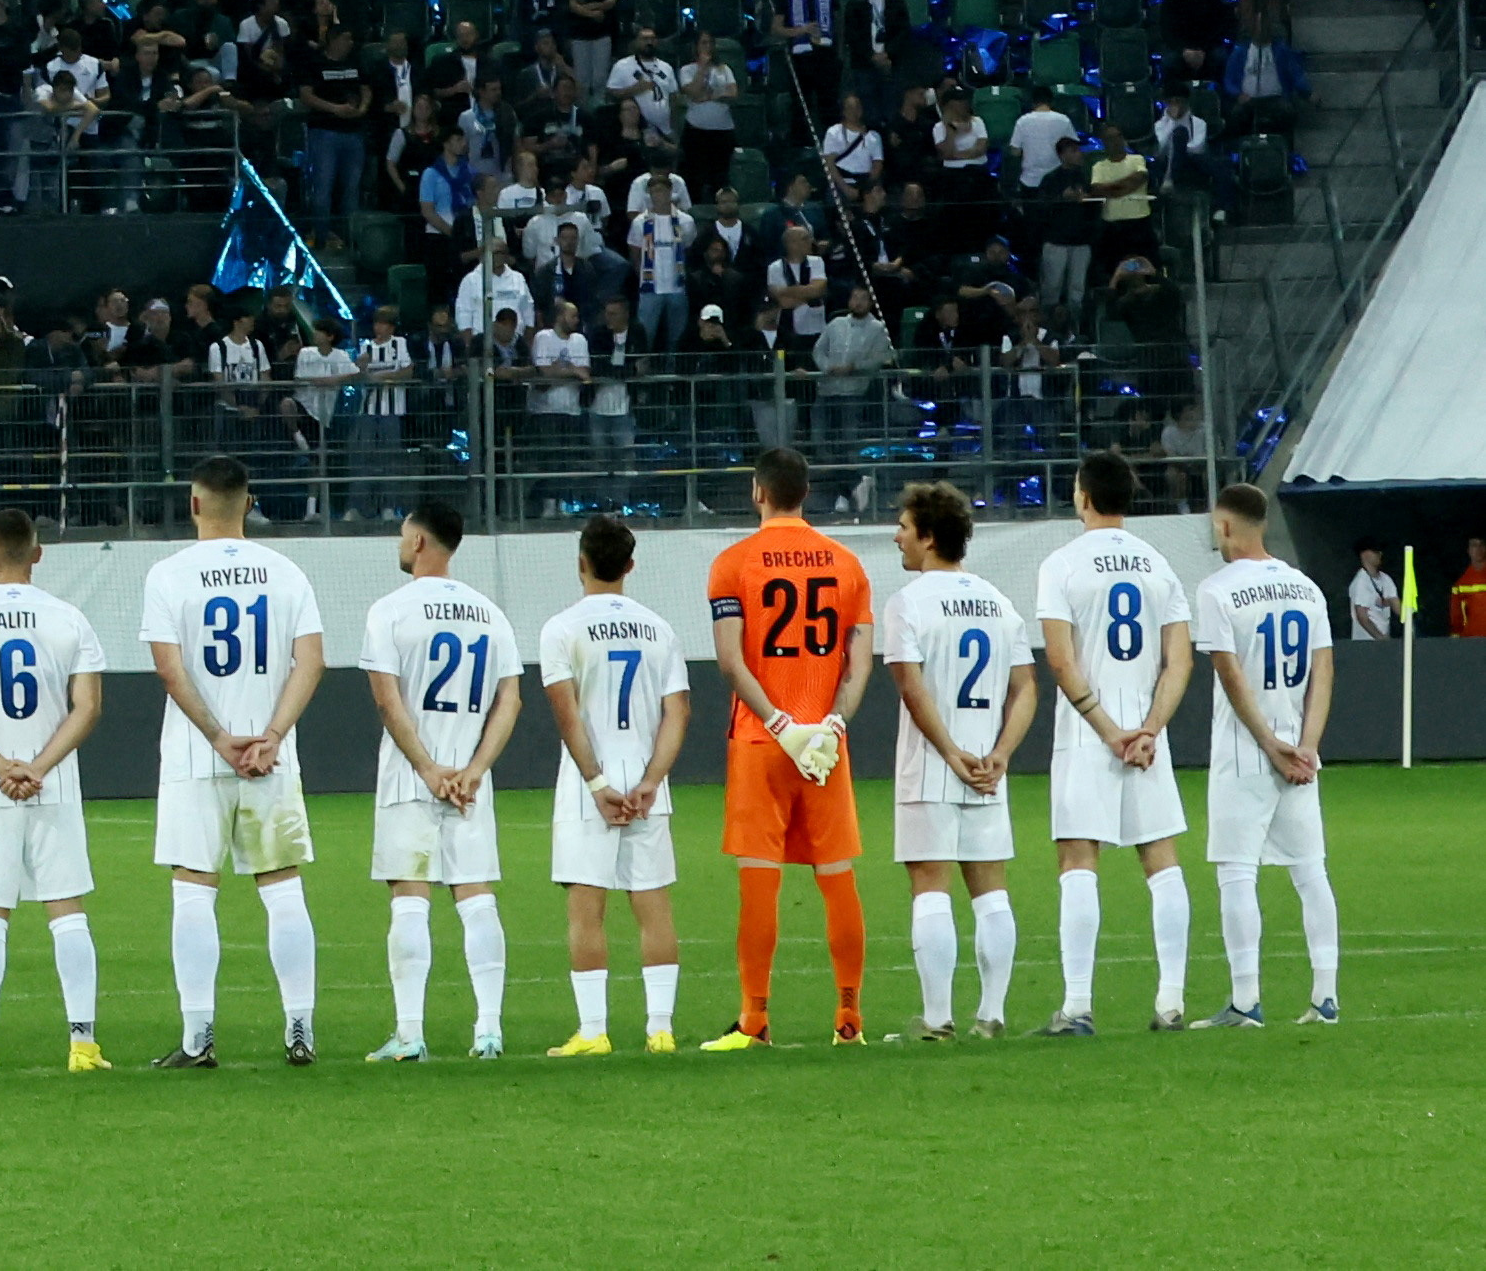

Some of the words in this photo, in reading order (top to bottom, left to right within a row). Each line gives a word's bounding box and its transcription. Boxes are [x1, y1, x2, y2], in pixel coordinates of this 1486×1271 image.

[200, 566, 268, 588] KRYEZIU
[762, 550, 835, 569] BRECHER
[1093, 555, 1152, 575] SELNÆS
[203, 594, 268, 677] 31
[423, 602, 491, 625] DZEMAILI
[587, 621, 657, 643] KRASNIQI
[762, 576, 839, 658] 25
[941, 599, 1003, 619] KAMBERI
[1106, 582, 1143, 662] 8
[422, 631, 490, 713] 21
[608, 650, 642, 730] 7
[956, 628, 991, 710] 2
[1256, 609, 1310, 691] 19
